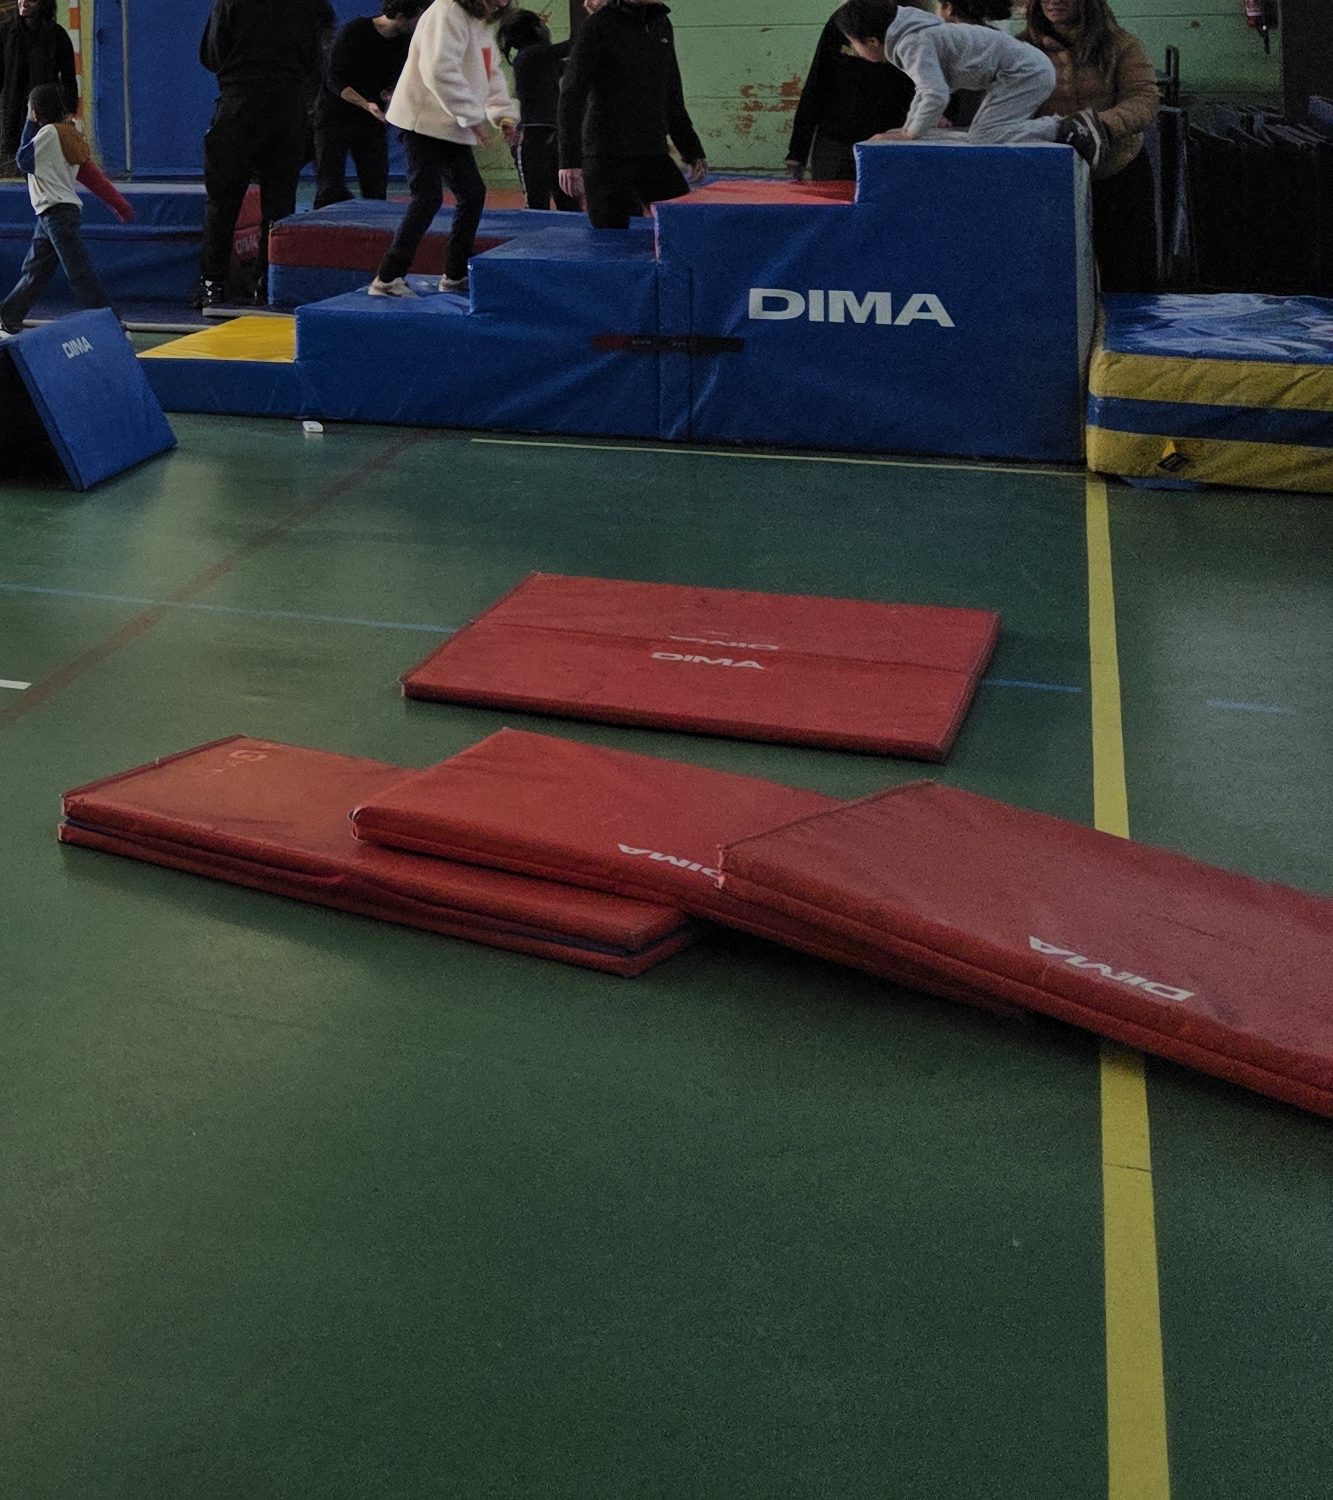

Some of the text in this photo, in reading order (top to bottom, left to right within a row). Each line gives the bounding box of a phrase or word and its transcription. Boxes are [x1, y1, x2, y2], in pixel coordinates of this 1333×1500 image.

[748, 287, 955, 328] DIMA
[61, 336, 94, 359] DIMA
[651, 651, 767, 670] DIMA
[1028, 935, 1196, 1002] DIMA
